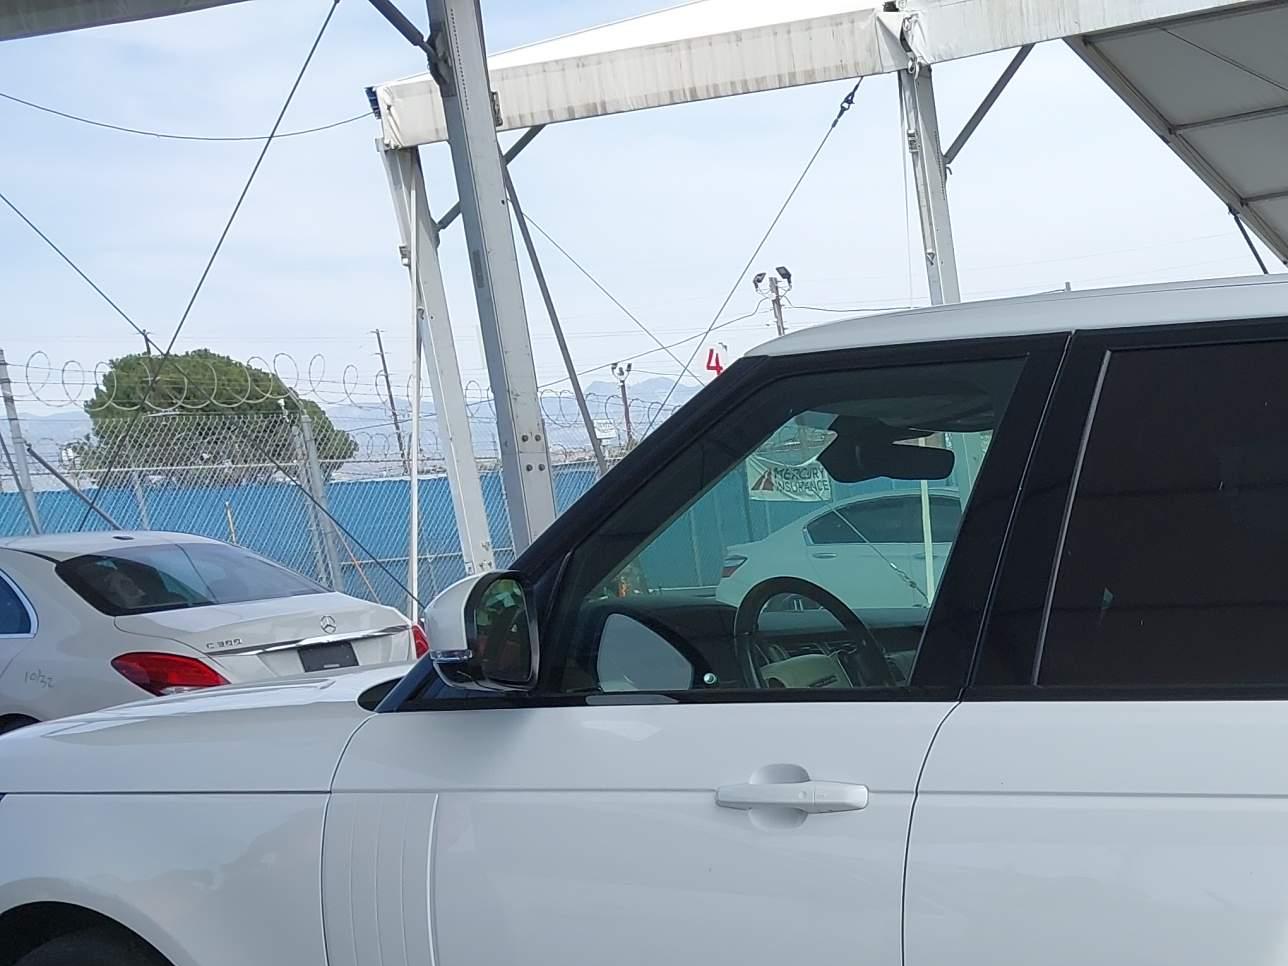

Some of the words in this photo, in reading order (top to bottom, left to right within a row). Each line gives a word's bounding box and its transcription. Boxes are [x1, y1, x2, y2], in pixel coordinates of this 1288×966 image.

[706, 348, 724, 376] 4
[774, 467, 825, 480] MERCURY
[774, 479, 830, 492] INSURANCE
